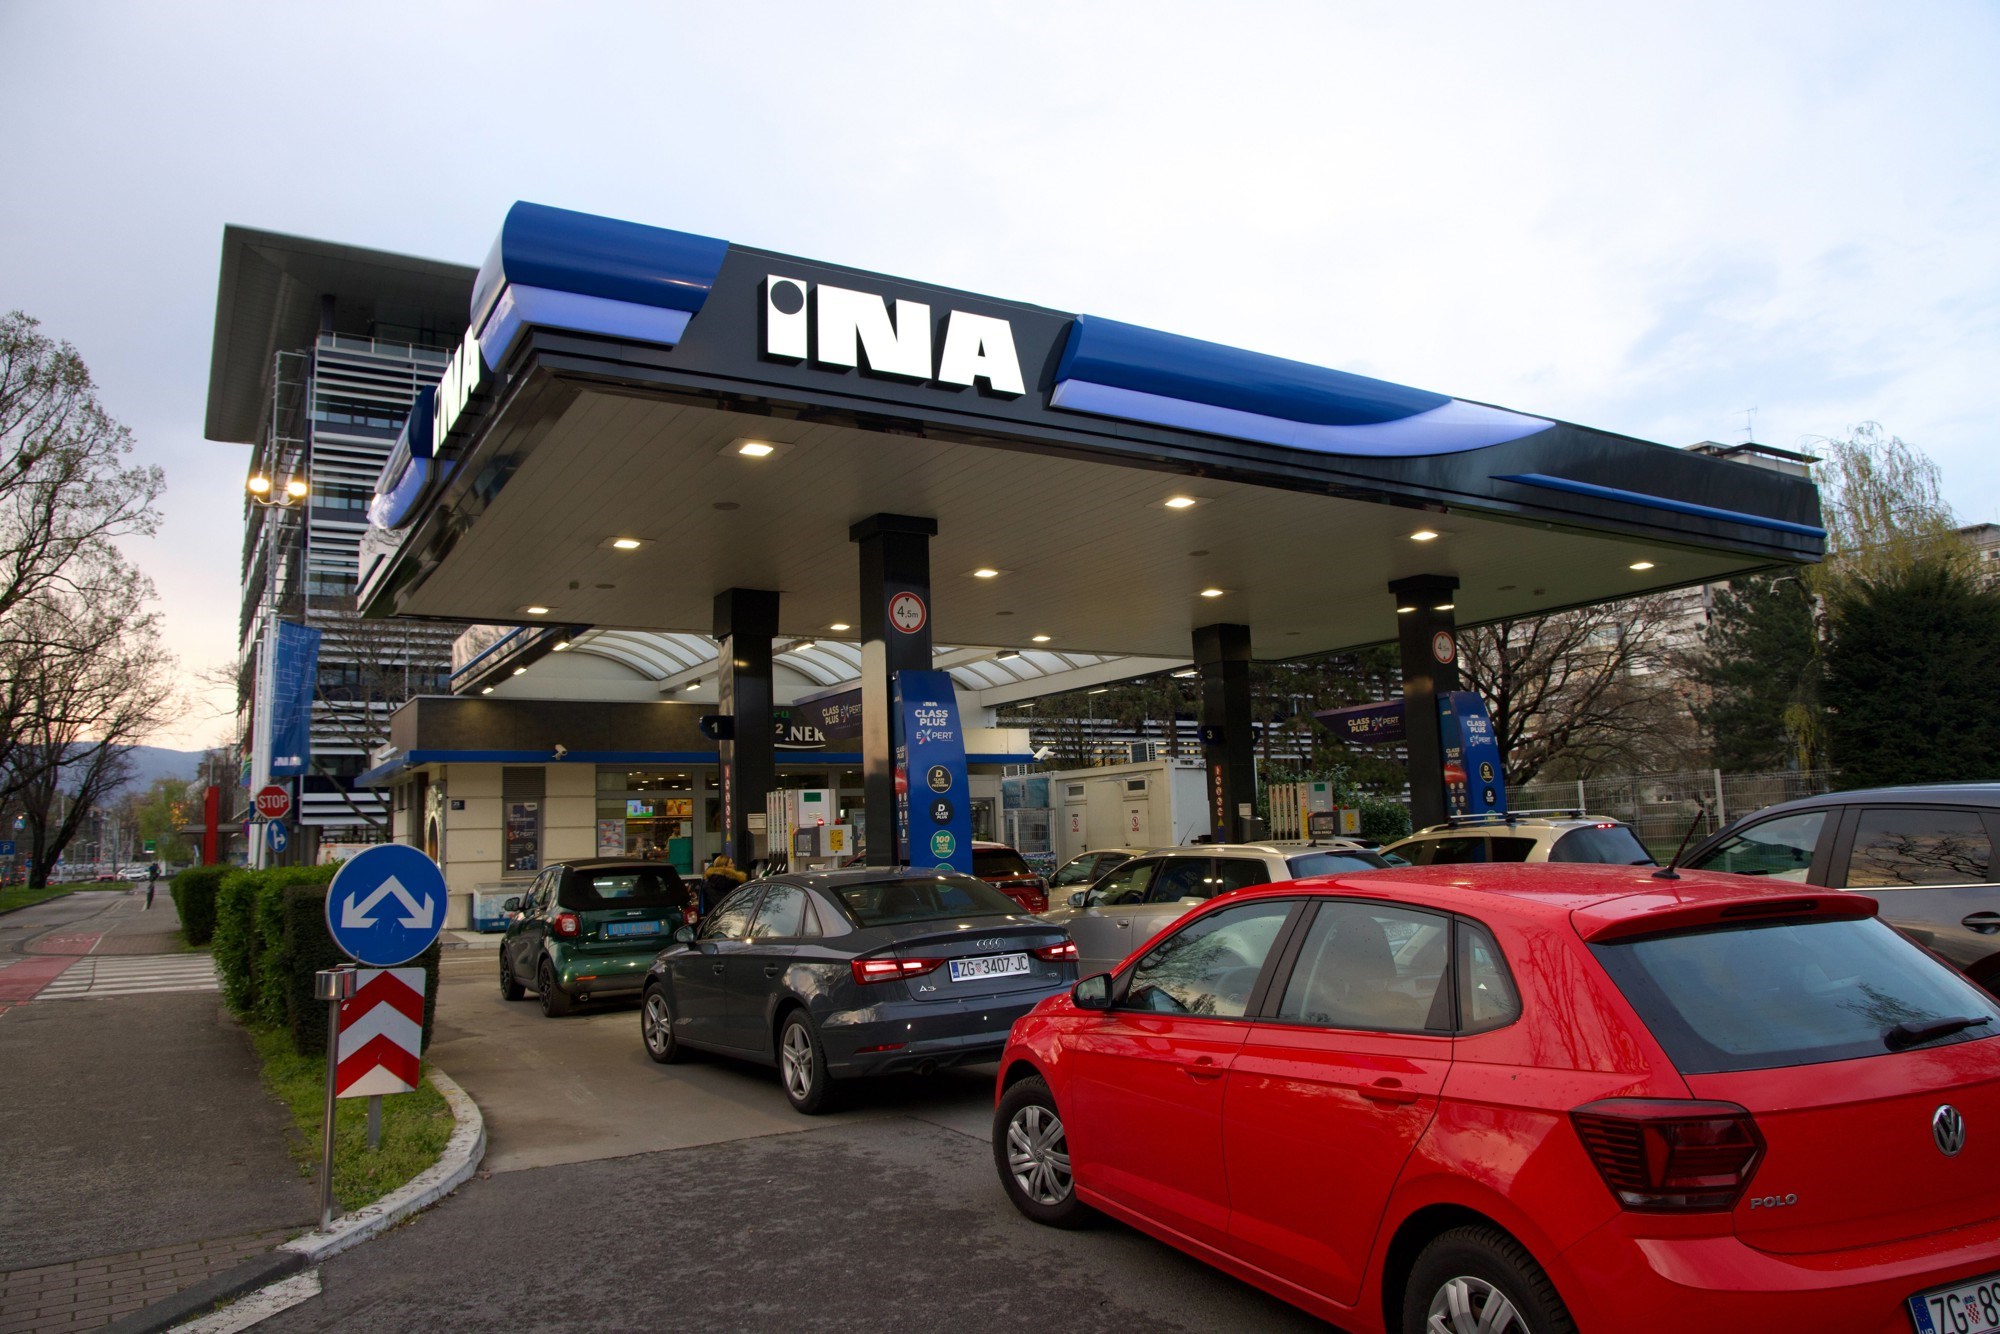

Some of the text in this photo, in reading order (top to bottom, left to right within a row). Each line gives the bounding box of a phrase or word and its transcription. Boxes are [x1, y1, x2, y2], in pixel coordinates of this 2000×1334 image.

[822, 706, 839, 716] CLASS
[914, 710, 948, 718] CLASS
[826, 715, 839, 725] PLUS
[920, 718, 946, 726] PLUS
[1348, 716, 1399, 731] CLASS EXPERT
[712, 722, 718, 733] 1
[776, 724, 783, 734] 2
[916, 728, 953, 744] EXPERT
[1207, 730, 1213, 739] 3
[259, 795, 288, 809] STOP
[960, 961, 975, 977] ZG
[1750, 1194, 1798, 1210] POLO
[1930, 1294, 1969, 1334] ZG
